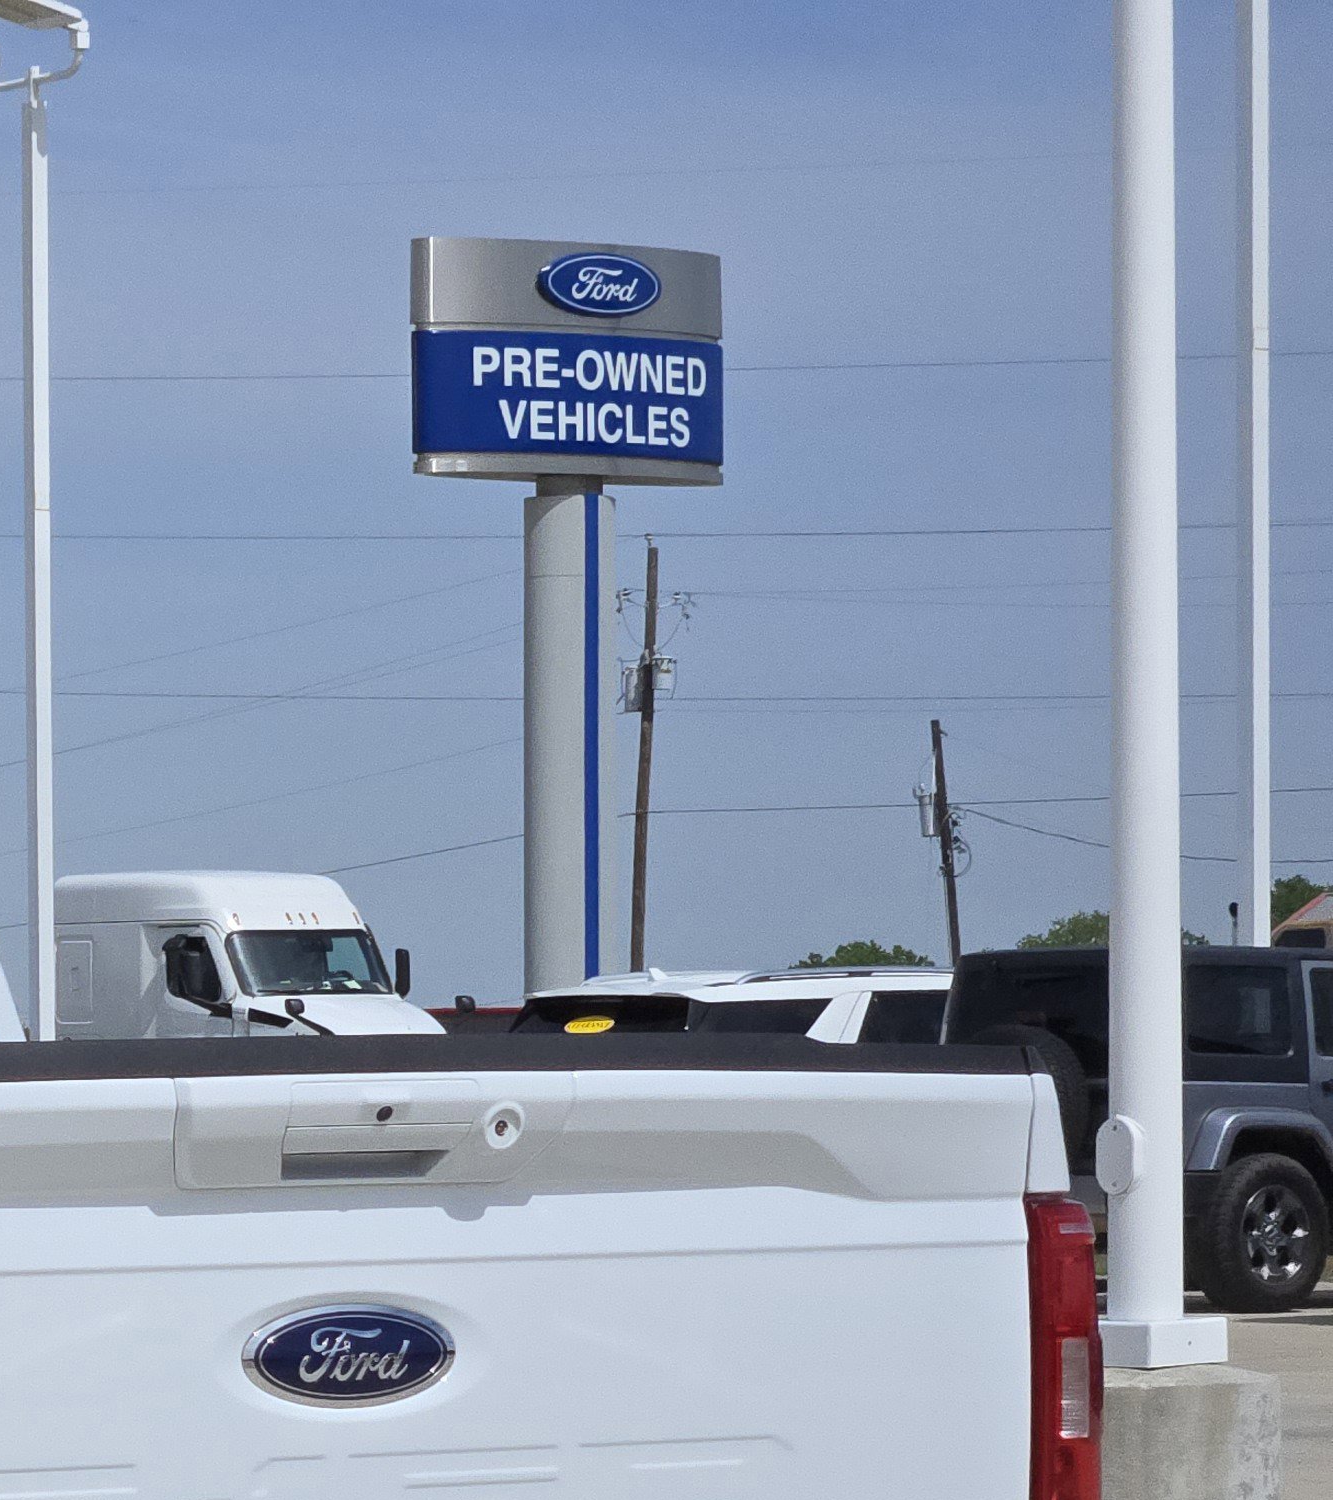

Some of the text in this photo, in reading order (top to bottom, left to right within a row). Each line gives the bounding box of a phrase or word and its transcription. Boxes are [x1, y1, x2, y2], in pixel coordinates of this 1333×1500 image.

[571, 266, 638, 303] Ford
[472, 345, 707, 398] PRE-OWNED
[499, 399, 691, 448] VEHICLES
[299, 1326, 411, 1383] Ford
